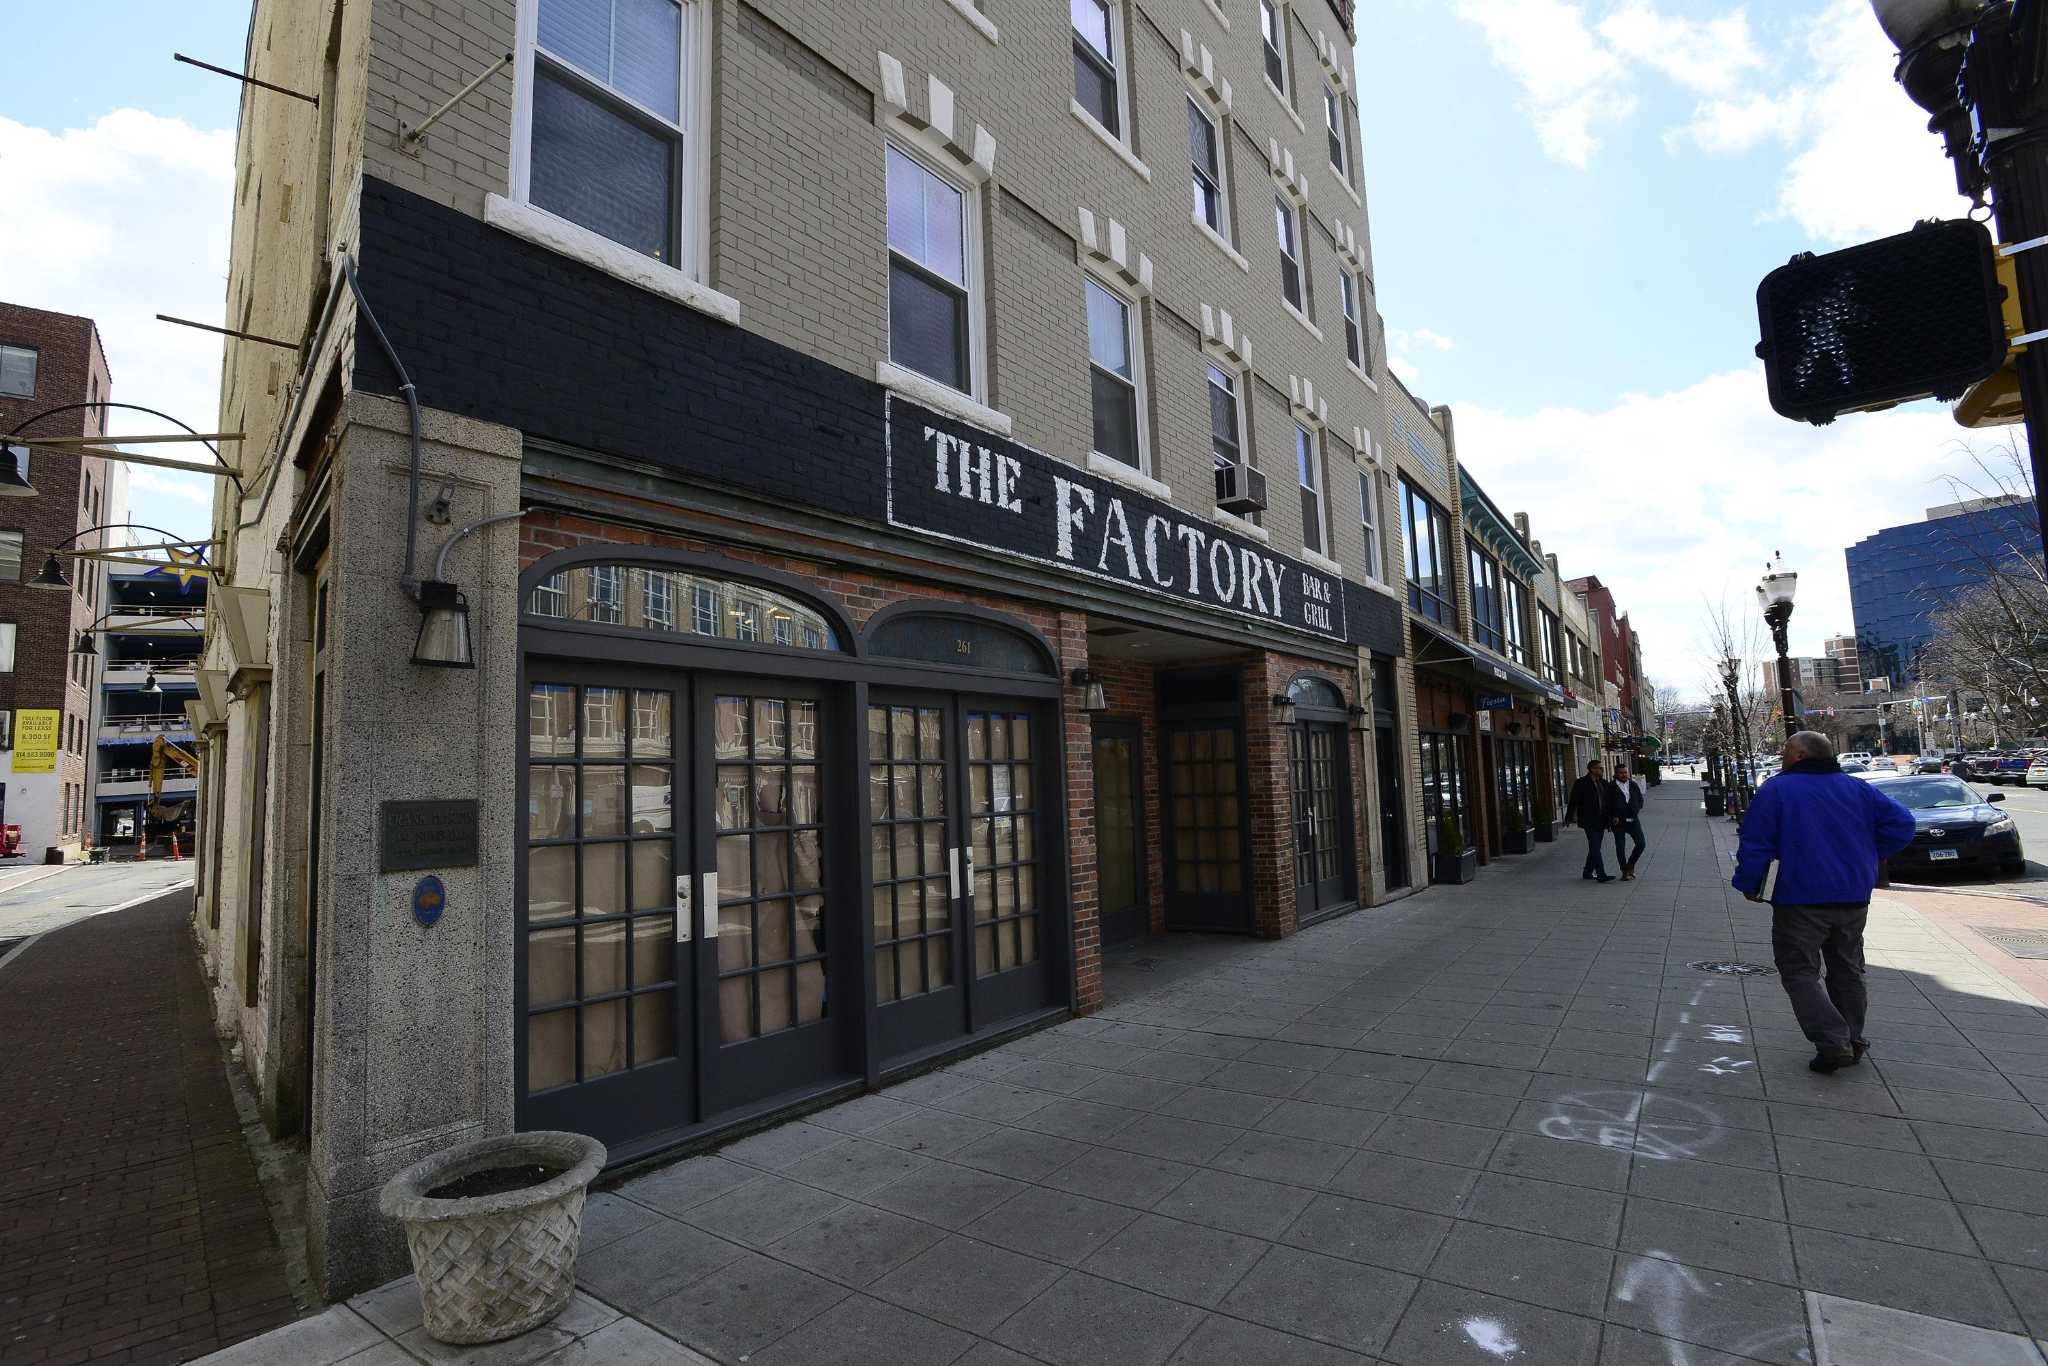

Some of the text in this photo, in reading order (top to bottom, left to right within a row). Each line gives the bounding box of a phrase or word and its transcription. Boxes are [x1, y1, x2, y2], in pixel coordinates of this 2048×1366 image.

[924, 426, 1286, 618] THE FACTORY
[1303, 572, 1331, 604] BAR &
[1304, 602, 1333, 631] GRILL
[956, 639, 971, 654] 261
